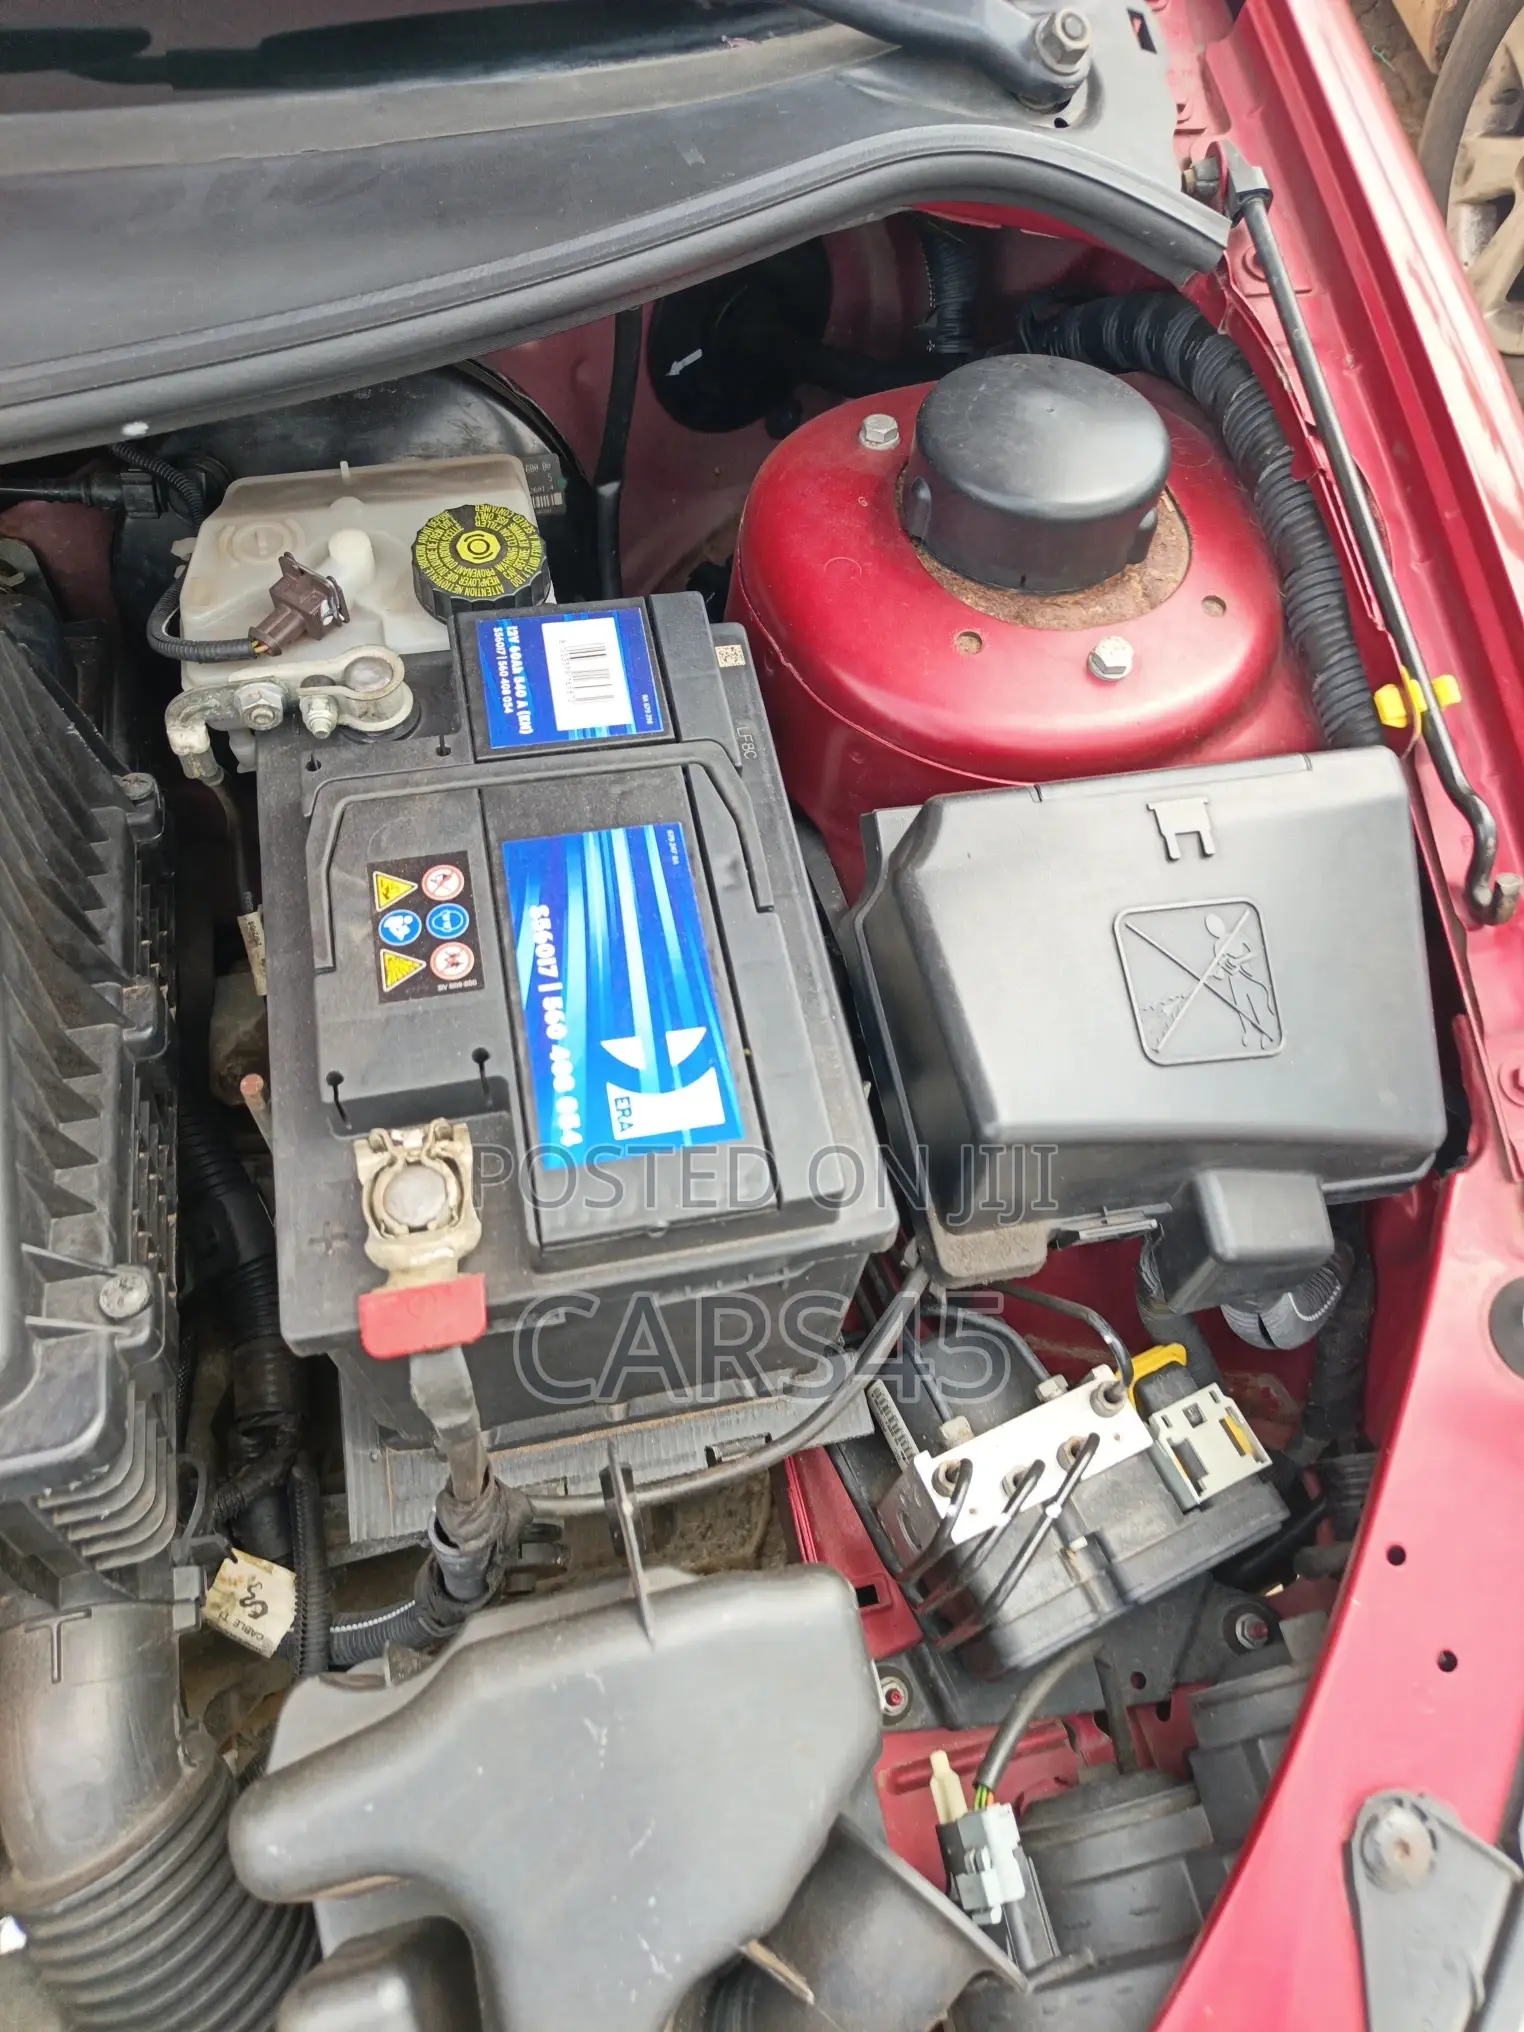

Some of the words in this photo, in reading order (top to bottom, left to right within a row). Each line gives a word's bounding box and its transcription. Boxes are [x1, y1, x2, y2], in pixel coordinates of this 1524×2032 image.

[473, 511, 495, 521] ONLY
[474, 503, 515, 518] CONTAINER
[438, 518, 453, 530] DOT
[473, 519, 503, 531] FILLER
[493, 514, 510, 526] USE
[510, 513, 536, 534] SEALED
[416, 525, 433, 543] AVANT
[497, 526, 519, 546] CLEAN
[530, 539, 542, 557] FROM
[493, 546, 518, 573] WARNING
[511, 547, 530, 571] BEFORE
[523, 556, 541, 574] FLUID
[422, 566, 435, 577] LE
[435, 565, 449, 576] DU
[442, 570, 460, 583] QUE
[452, 563, 496, 578] PROVENANT
[501, 566, 519, 580] CAP
[427, 572, 464, 595] NETTOYER
[509, 574, 526, 587] DOT
[463, 584, 506, 597] ATTENTION
[493, 627, 507, 655] S56017
[506, 625, 520, 643] 12V
[509, 645, 524, 674] 60Ah
[497, 661, 509, 677] 560
[500, 678, 511, 695] 408
[513, 676, 527, 698] 540
[502, 696, 514, 714] 054
[516, 700, 529, 709] A
[516, 710, 534, 735] (EN)
[528, 904, 559, 978] S56017
[542, 996, 568, 1040] 560
[548, 1044, 576, 1094] 408
[555, 1095, 584, 1147] 054
[614, 1096, 634, 1132] ERA
[233, 1618, 264, 1641] CABLE
